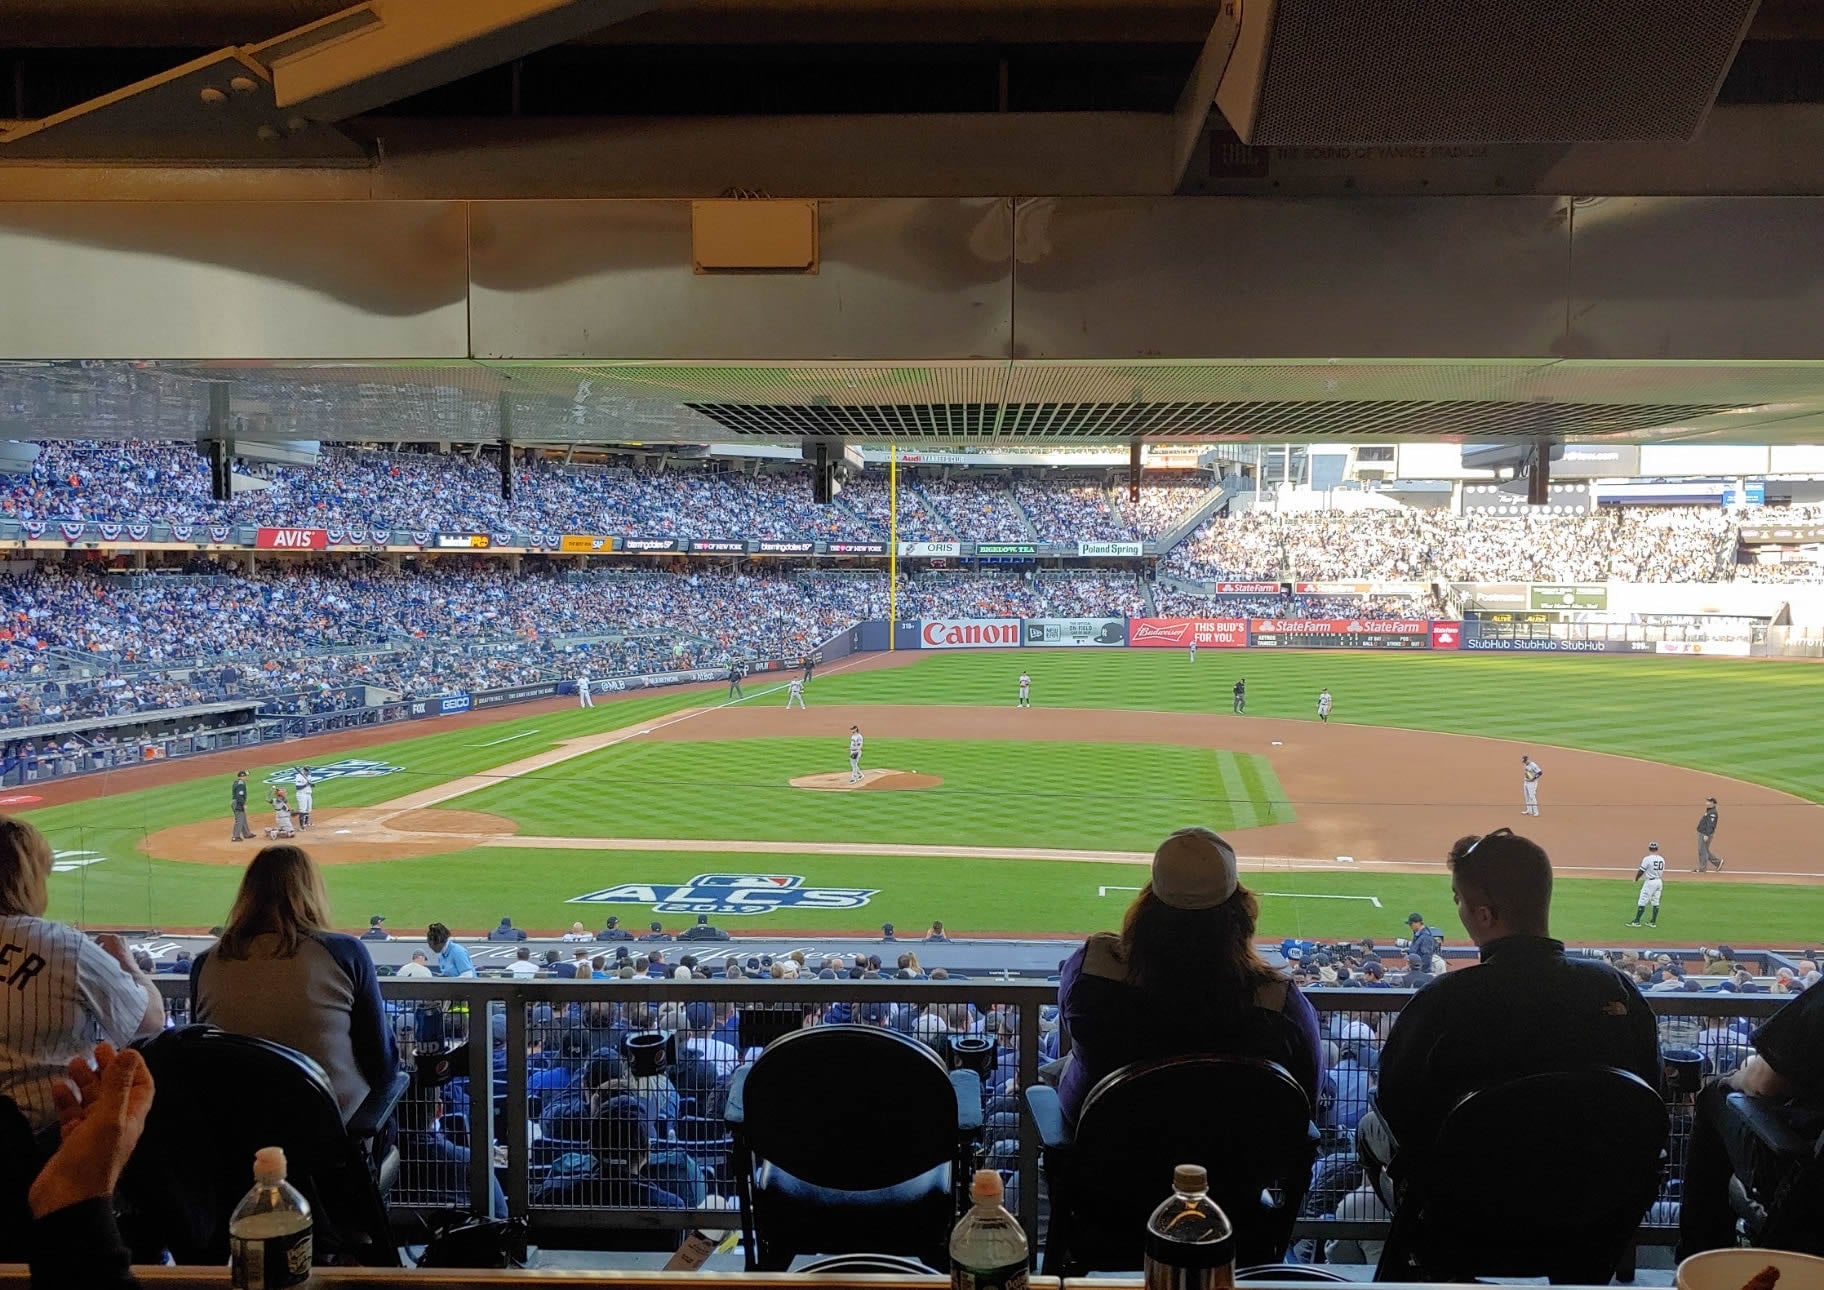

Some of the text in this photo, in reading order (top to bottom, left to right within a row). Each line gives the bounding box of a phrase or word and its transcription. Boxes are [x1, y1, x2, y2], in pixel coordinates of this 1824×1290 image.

[1304, 146, 1351, 160] SOUND
[1354, 146, 1376, 160] OF
[1377, 146, 1425, 160] YANKEE
[273, 530, 312, 547] AVIS
[928, 543, 953, 552] ORIS
[1082, 544, 1139, 555] Poland Spring
[1139, 624, 1184, 637] Budweiser
[1194, 622, 1244, 632] THIS BUD'S
[923, 622, 1018, 646] Canon
[1195, 633, 1235, 642] FOR YOU.
[1468, 638, 1605, 651] StubHub StubHub StubHub
[601, 680, 626, 691] @MLB
[412, 703, 426, 715] FOX
[442, 697, 470, 710] GEICO
[1653, 860, 1664, 871] 50
[590, 885, 867, 907] ALCS
[665, 903, 763, 913] 2019
[415, 1040, 440, 1054] UD
